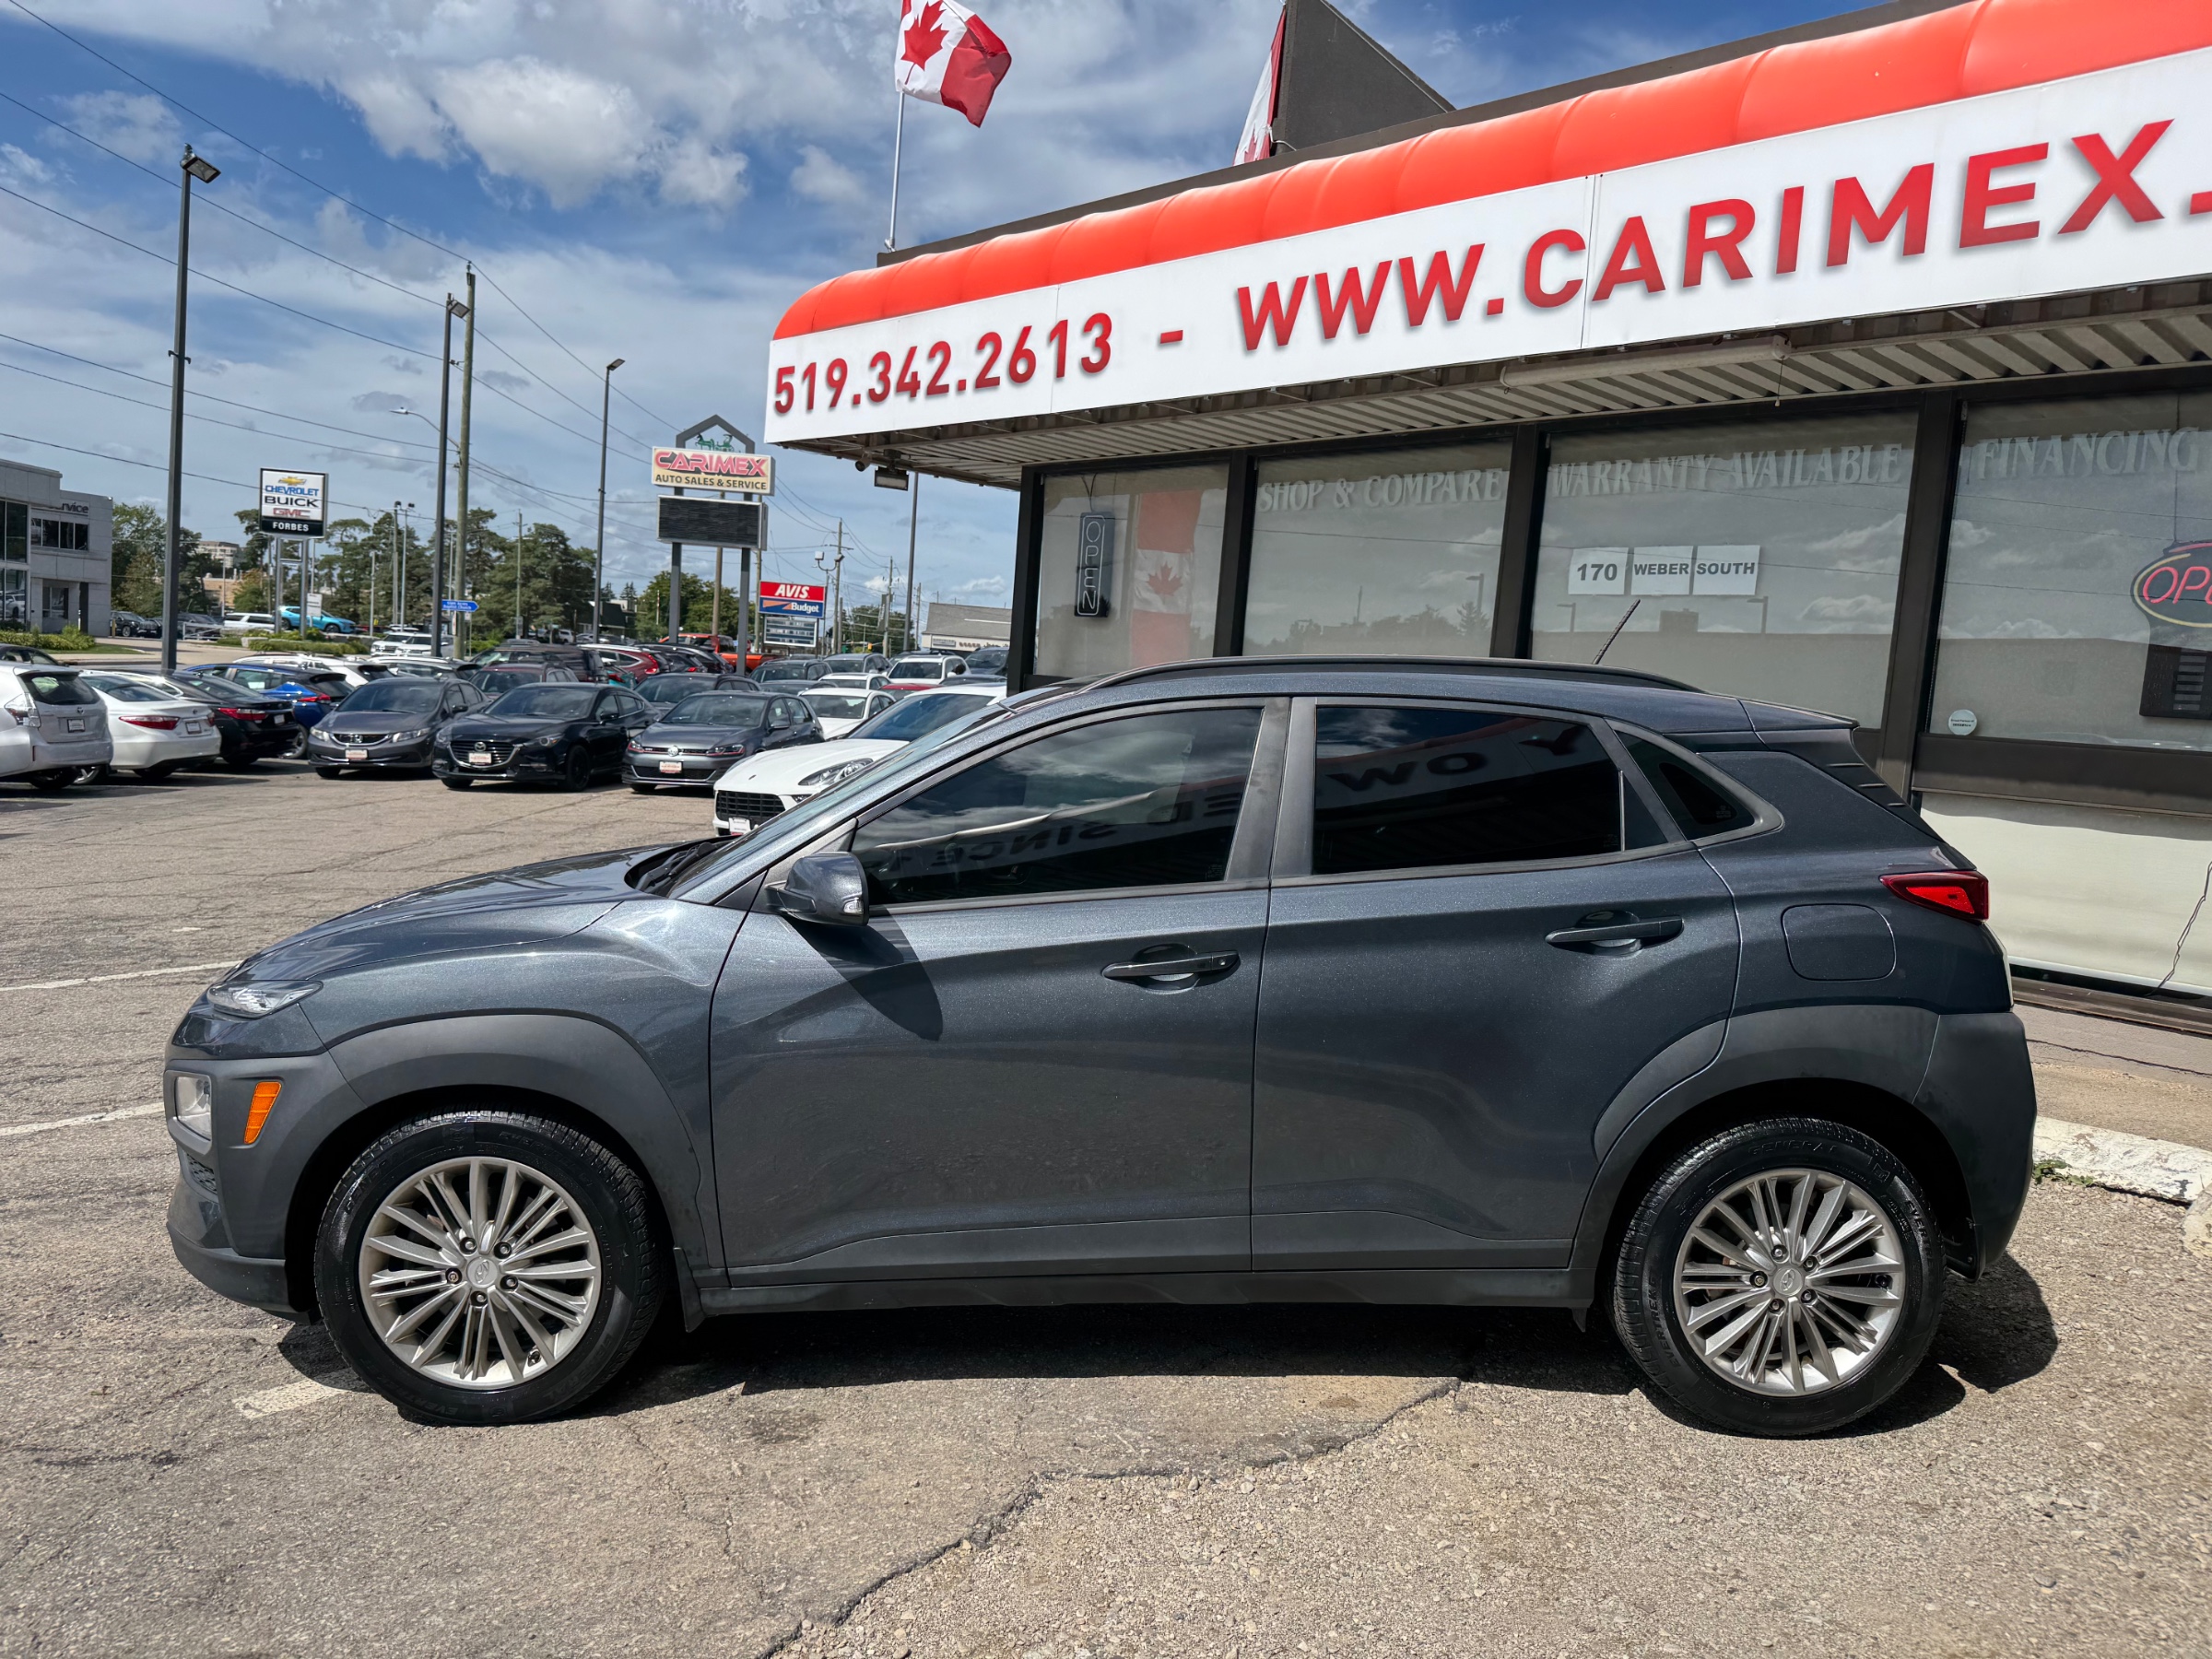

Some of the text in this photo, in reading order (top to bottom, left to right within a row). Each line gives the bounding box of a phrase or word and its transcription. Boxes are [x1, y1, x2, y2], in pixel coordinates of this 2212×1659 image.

[774, 312, 1112, 415] 519.342.2613
[655, 450, 769, 477] CARIMEX
[1978, 426, 2199, 480] FINANCING
[1549, 443, 1902, 498] WARRANTY AVAILABLE
[265, 485, 320, 497] CHEVROLET
[655, 474, 767, 490] AUTO SALES & SERVICE
[1257, 467, 1504, 513] SHOP & COMPARE
[62, 501, 89, 513] rvice
[264, 495, 320, 508] BUICK
[273, 508, 311, 518] GMC
[273, 521, 310, 532] FORBES
[1082, 521, 1101, 610] OPEN
[1576, 561, 1756, 582] 170 WEBER SOUTH
[774, 583, 810, 599] AVIS
[2142, 566, 2212, 605] OP
[791, 602, 819, 614] Budget
[1647, 1288, 1681, 1370] EVERTREK
